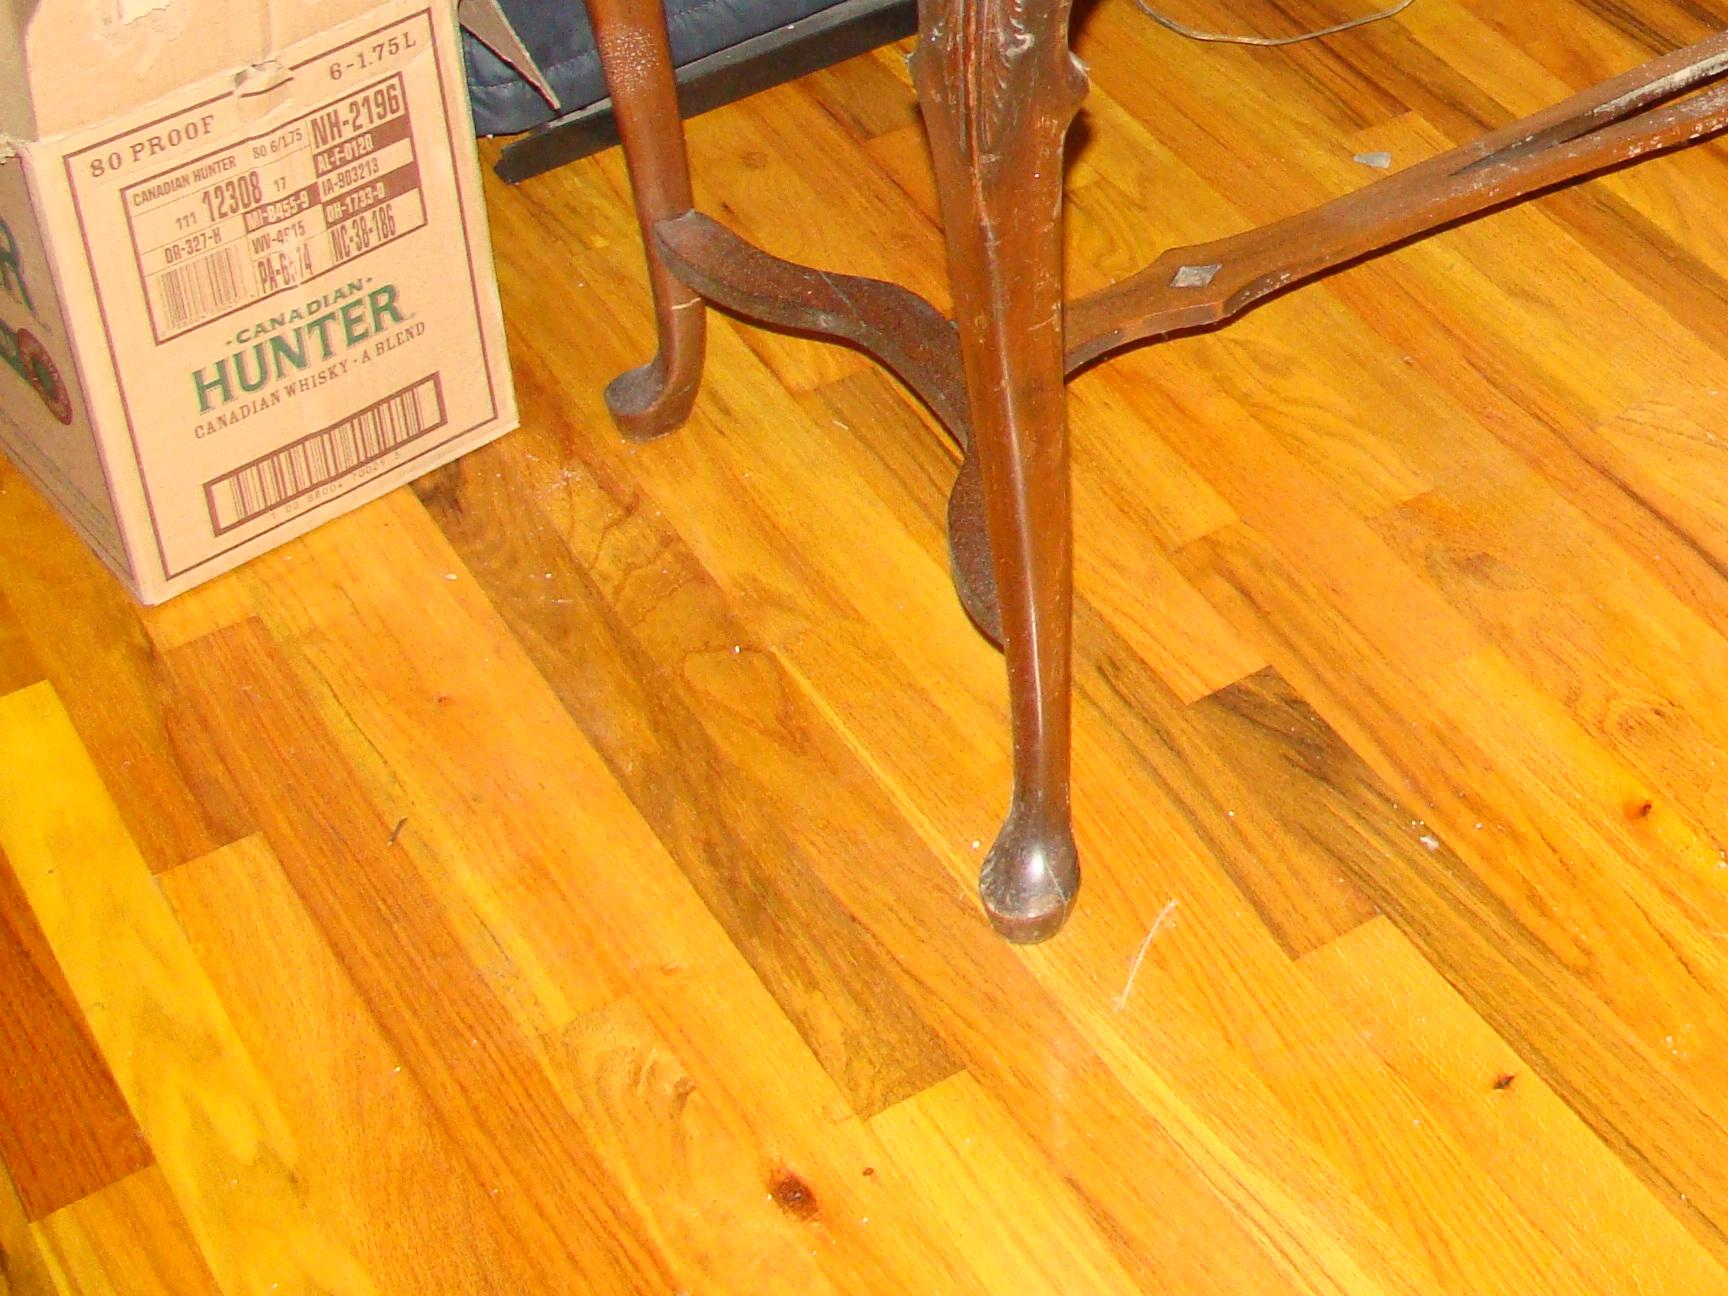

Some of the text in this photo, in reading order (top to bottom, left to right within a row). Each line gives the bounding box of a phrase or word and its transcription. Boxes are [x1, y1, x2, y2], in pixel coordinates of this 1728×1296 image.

[89, 114, 215, 178] 80 PROOF
[310, 82, 401, 149] NH-2196
[132, 174, 191, 207] CANADIAN
[192, 155, 237, 183] HUNTER
[201, 170, 264, 223] 12308
[320, 157, 380, 197] IA-903213
[330, 202, 397, 263] NC-38-186
[191, 283, 408, 416] HUNTER
[194, 389, 281, 440] CANADIAN
[283, 357, 350, 399] WHISKY
[360, 348, 373, 365] A
[374, 320, 427, 357] BLEND
